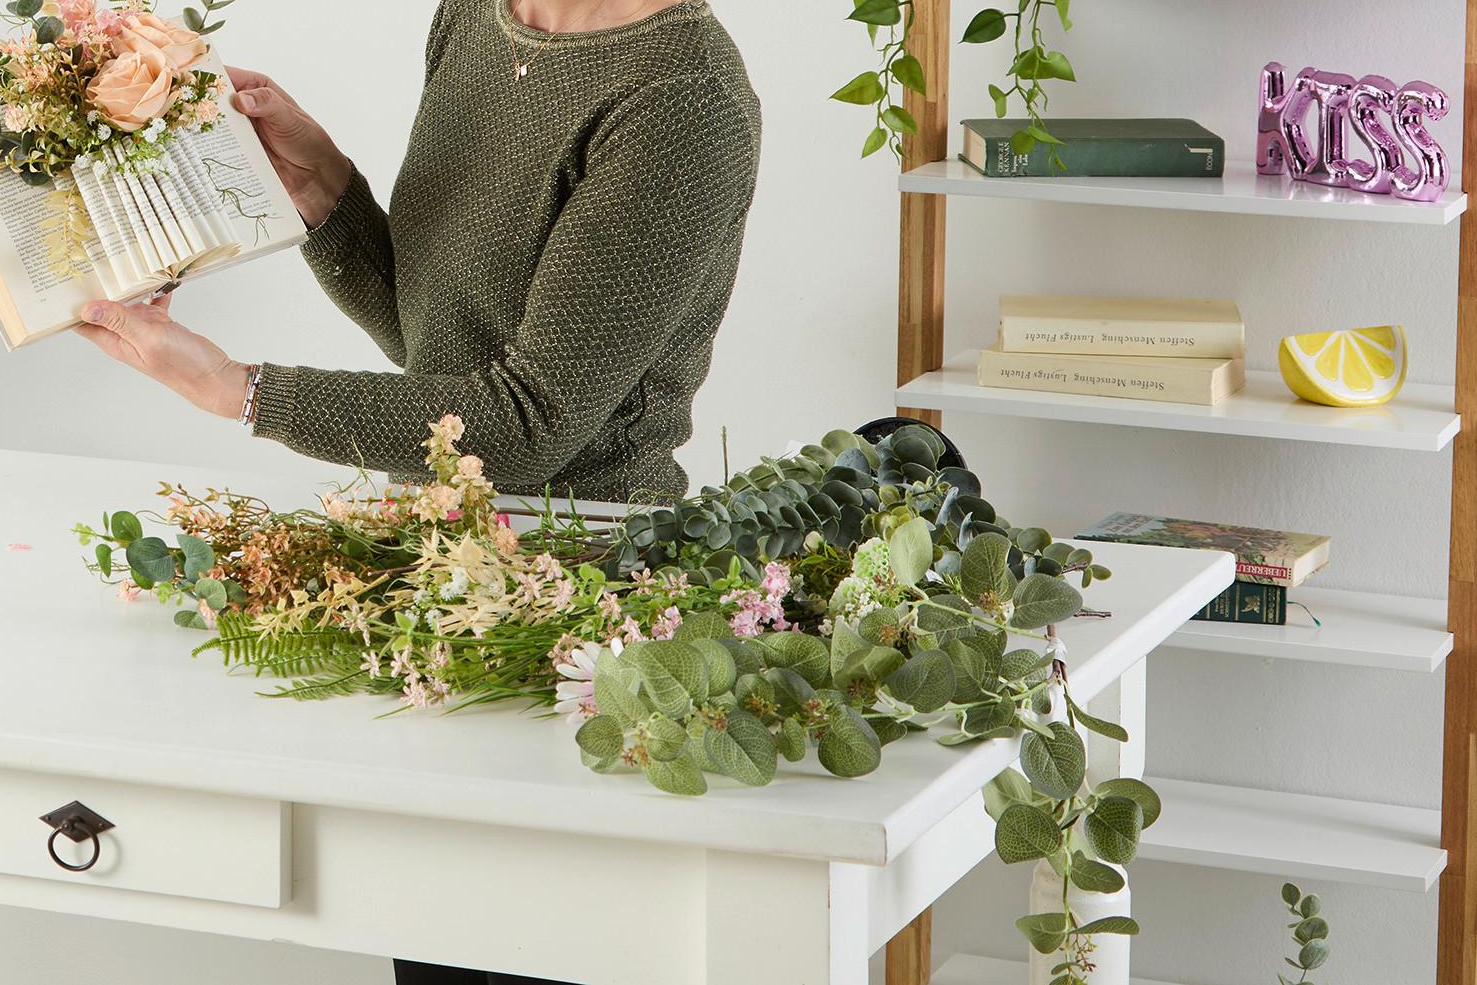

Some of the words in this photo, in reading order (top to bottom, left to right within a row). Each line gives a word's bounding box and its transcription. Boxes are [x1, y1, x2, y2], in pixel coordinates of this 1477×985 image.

[1256, 61, 1451, 202] KISS
[1025, 332, 1057, 343] Flucht
[1059, 332, 1094, 343] Lustigs
[1101, 333, 1156, 344] Mensching
[1159, 336, 1195, 347] Steffen
[1000, 369, 1031, 380] Flucht
[1033, 370, 1067, 383] Lustigs
[1074, 373, 1127, 387] Mensching
[1130, 380, 1165, 390] Steffen
